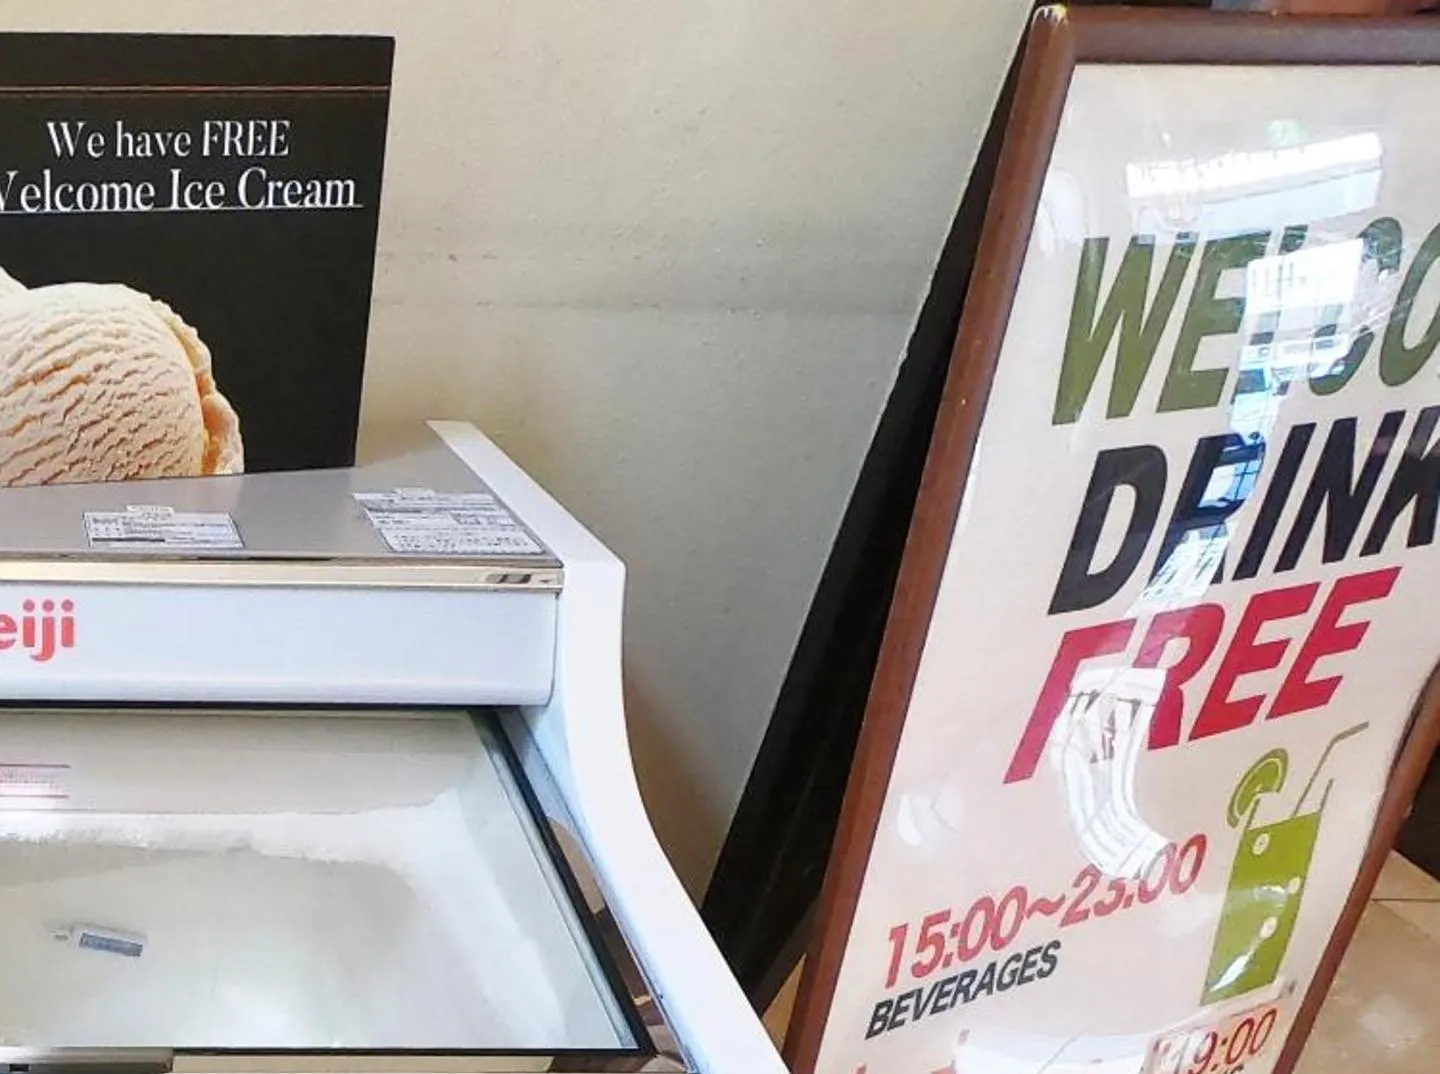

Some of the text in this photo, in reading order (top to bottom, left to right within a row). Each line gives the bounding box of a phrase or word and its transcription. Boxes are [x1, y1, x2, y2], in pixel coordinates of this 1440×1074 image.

[47, 120, 291, 158] We have FREE
[170, 168, 226, 209] Ice
[238, 167, 356, 209] Cream
[1003, 566, 1402, 784] FREE
[865, 940, 1062, 1040] BEVERAGES
